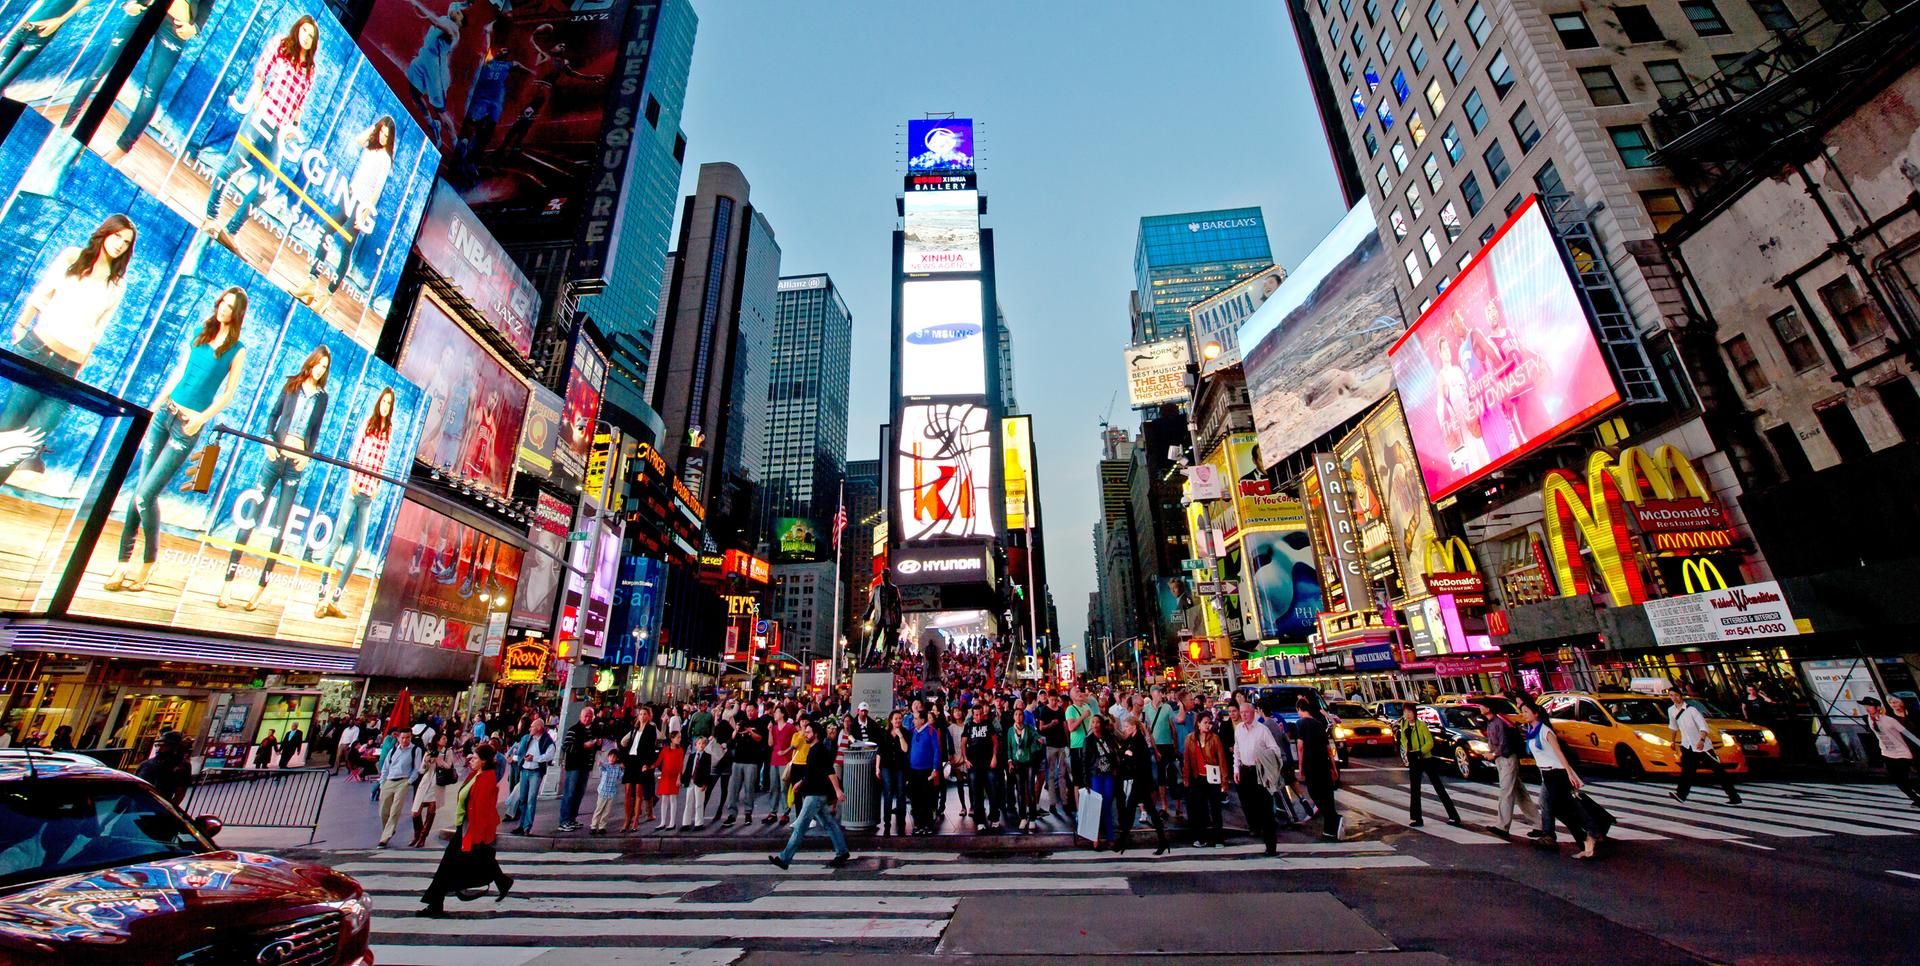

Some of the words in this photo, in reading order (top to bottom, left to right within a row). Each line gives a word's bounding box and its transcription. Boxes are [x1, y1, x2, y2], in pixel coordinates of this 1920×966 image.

[620, 5, 657, 95] TIMES
[228, 95, 378, 235] JEGGING
[585, 107, 631, 243] SQUARE
[258, 175, 336, 252] WASHES
[1202, 217, 1257, 231] BARCLAYS
[248, 203, 284, 240] WAYS
[287, 235, 302, 255] TO
[306, 252, 339, 285] WEAR
[454, 222, 493, 277] NBA
[921, 254, 964, 263] XINHUA
[777, 281, 807, 289] Allianz
[494, 301, 515, 327] JAY
[1198, 291, 1256, 336] MAMMA
[1132, 371, 1150, 379] BEST
[1153, 365, 1187, 375] MUSICAL
[1133, 376, 1156, 388] THE
[1134, 382, 1174, 394] MUSICAL
[1486, 355, 1542, 408] DYNASTY
[1136, 392, 1153, 400] THIS
[1262, 496, 1276, 504] You
[233, 487, 333, 551] CLEO
[1325, 462, 1360, 575] PALACE
[1639, 506, 1719, 521] McDonald's
[1656, 518, 1711, 527] Restaurant
[163, 548, 227, 573] STUDENT
[923, 558, 980, 571] HYUNDAI
[228, 562, 263, 583] FROM
[1430, 577, 1481, 587] McDonald's
[1723, 616, 1749, 625] EXTERIOR
[1754, 611, 1781, 621] INTERIOR
[405, 610, 447, 646] NBA
[1737, 623, 1786, 635] 541-0030
[511, 649, 543, 666] ROXY
[1368, 651, 1391, 662] EXCHANGE
[816, 662, 825, 686] tkts
